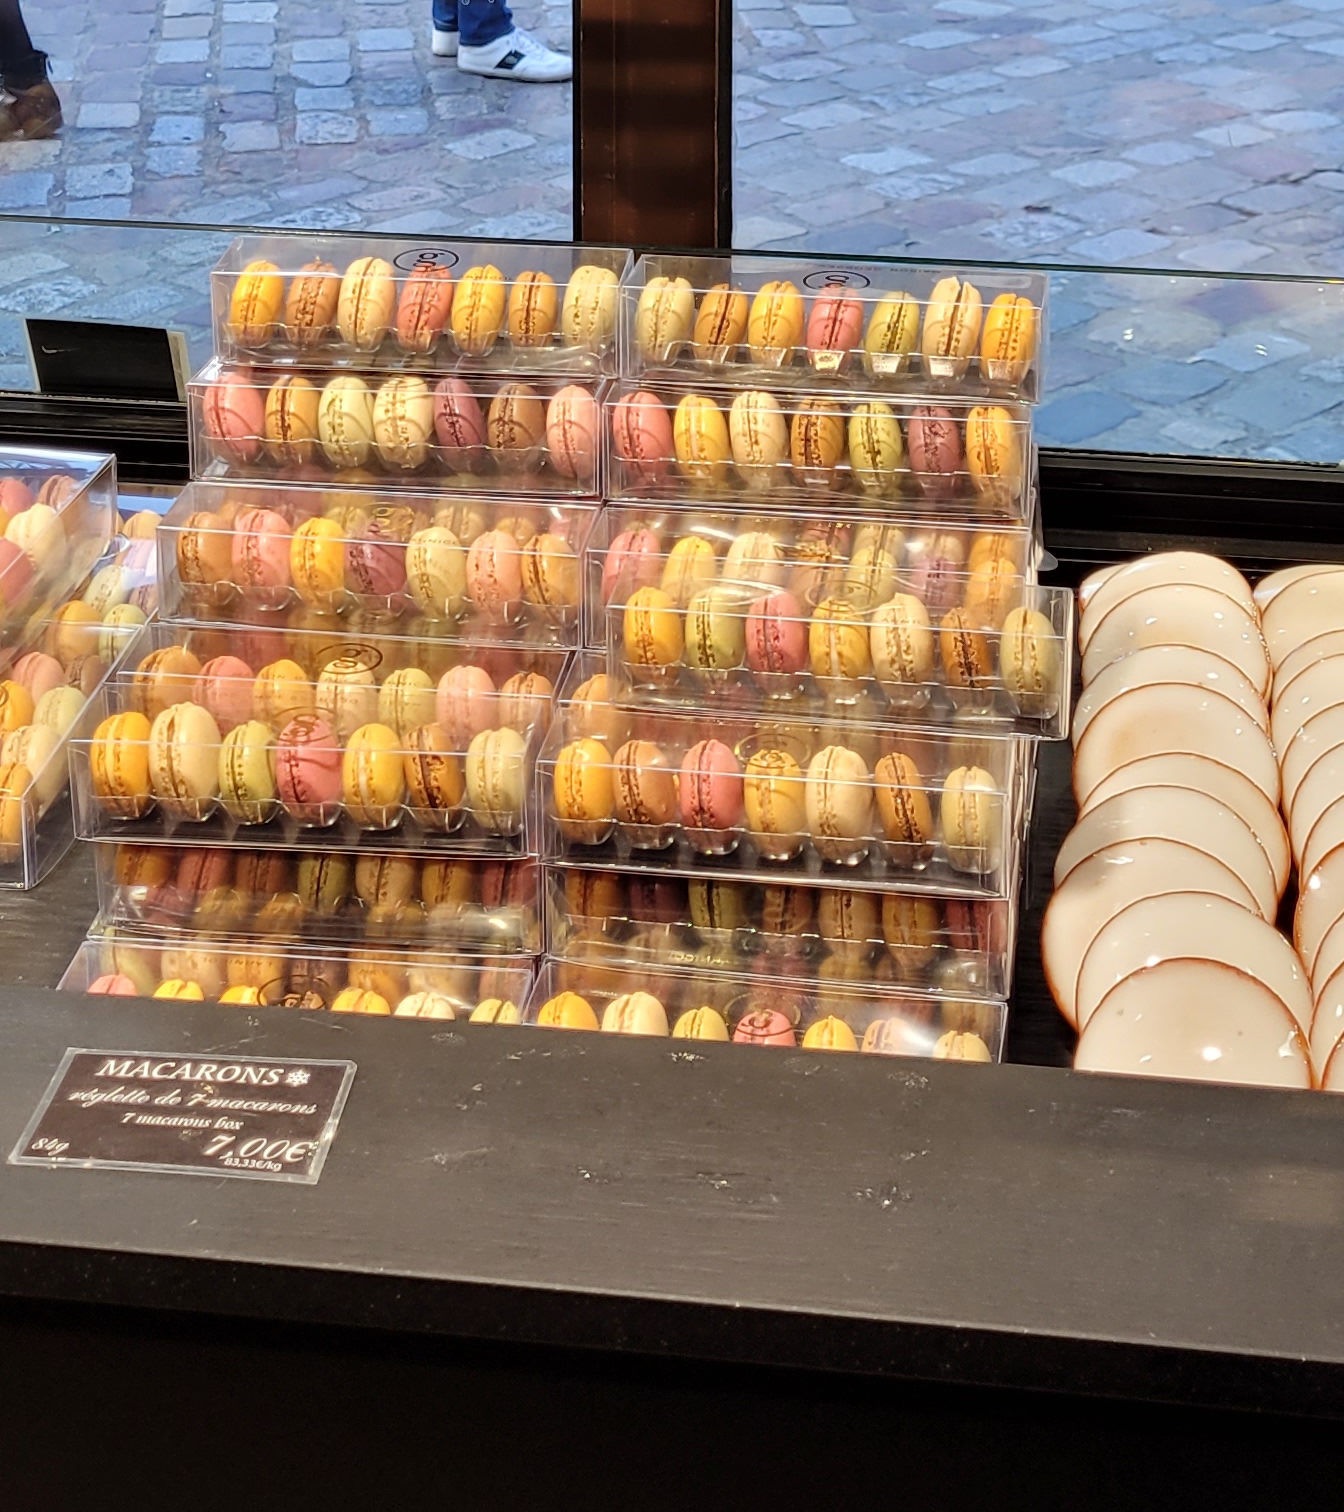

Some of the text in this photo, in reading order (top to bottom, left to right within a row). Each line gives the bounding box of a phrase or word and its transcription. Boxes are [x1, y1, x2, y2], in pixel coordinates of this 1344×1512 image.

[95, 1059, 285, 1086] MACARONS
[68, 1086, 317, 1115] réglette de 7 macarons
[122, 1113, 245, 1131] 7 macarons box
[202, 1134, 312, 1162] 7,00€
[223, 1157, 283, 1172] 83,33€/kg
